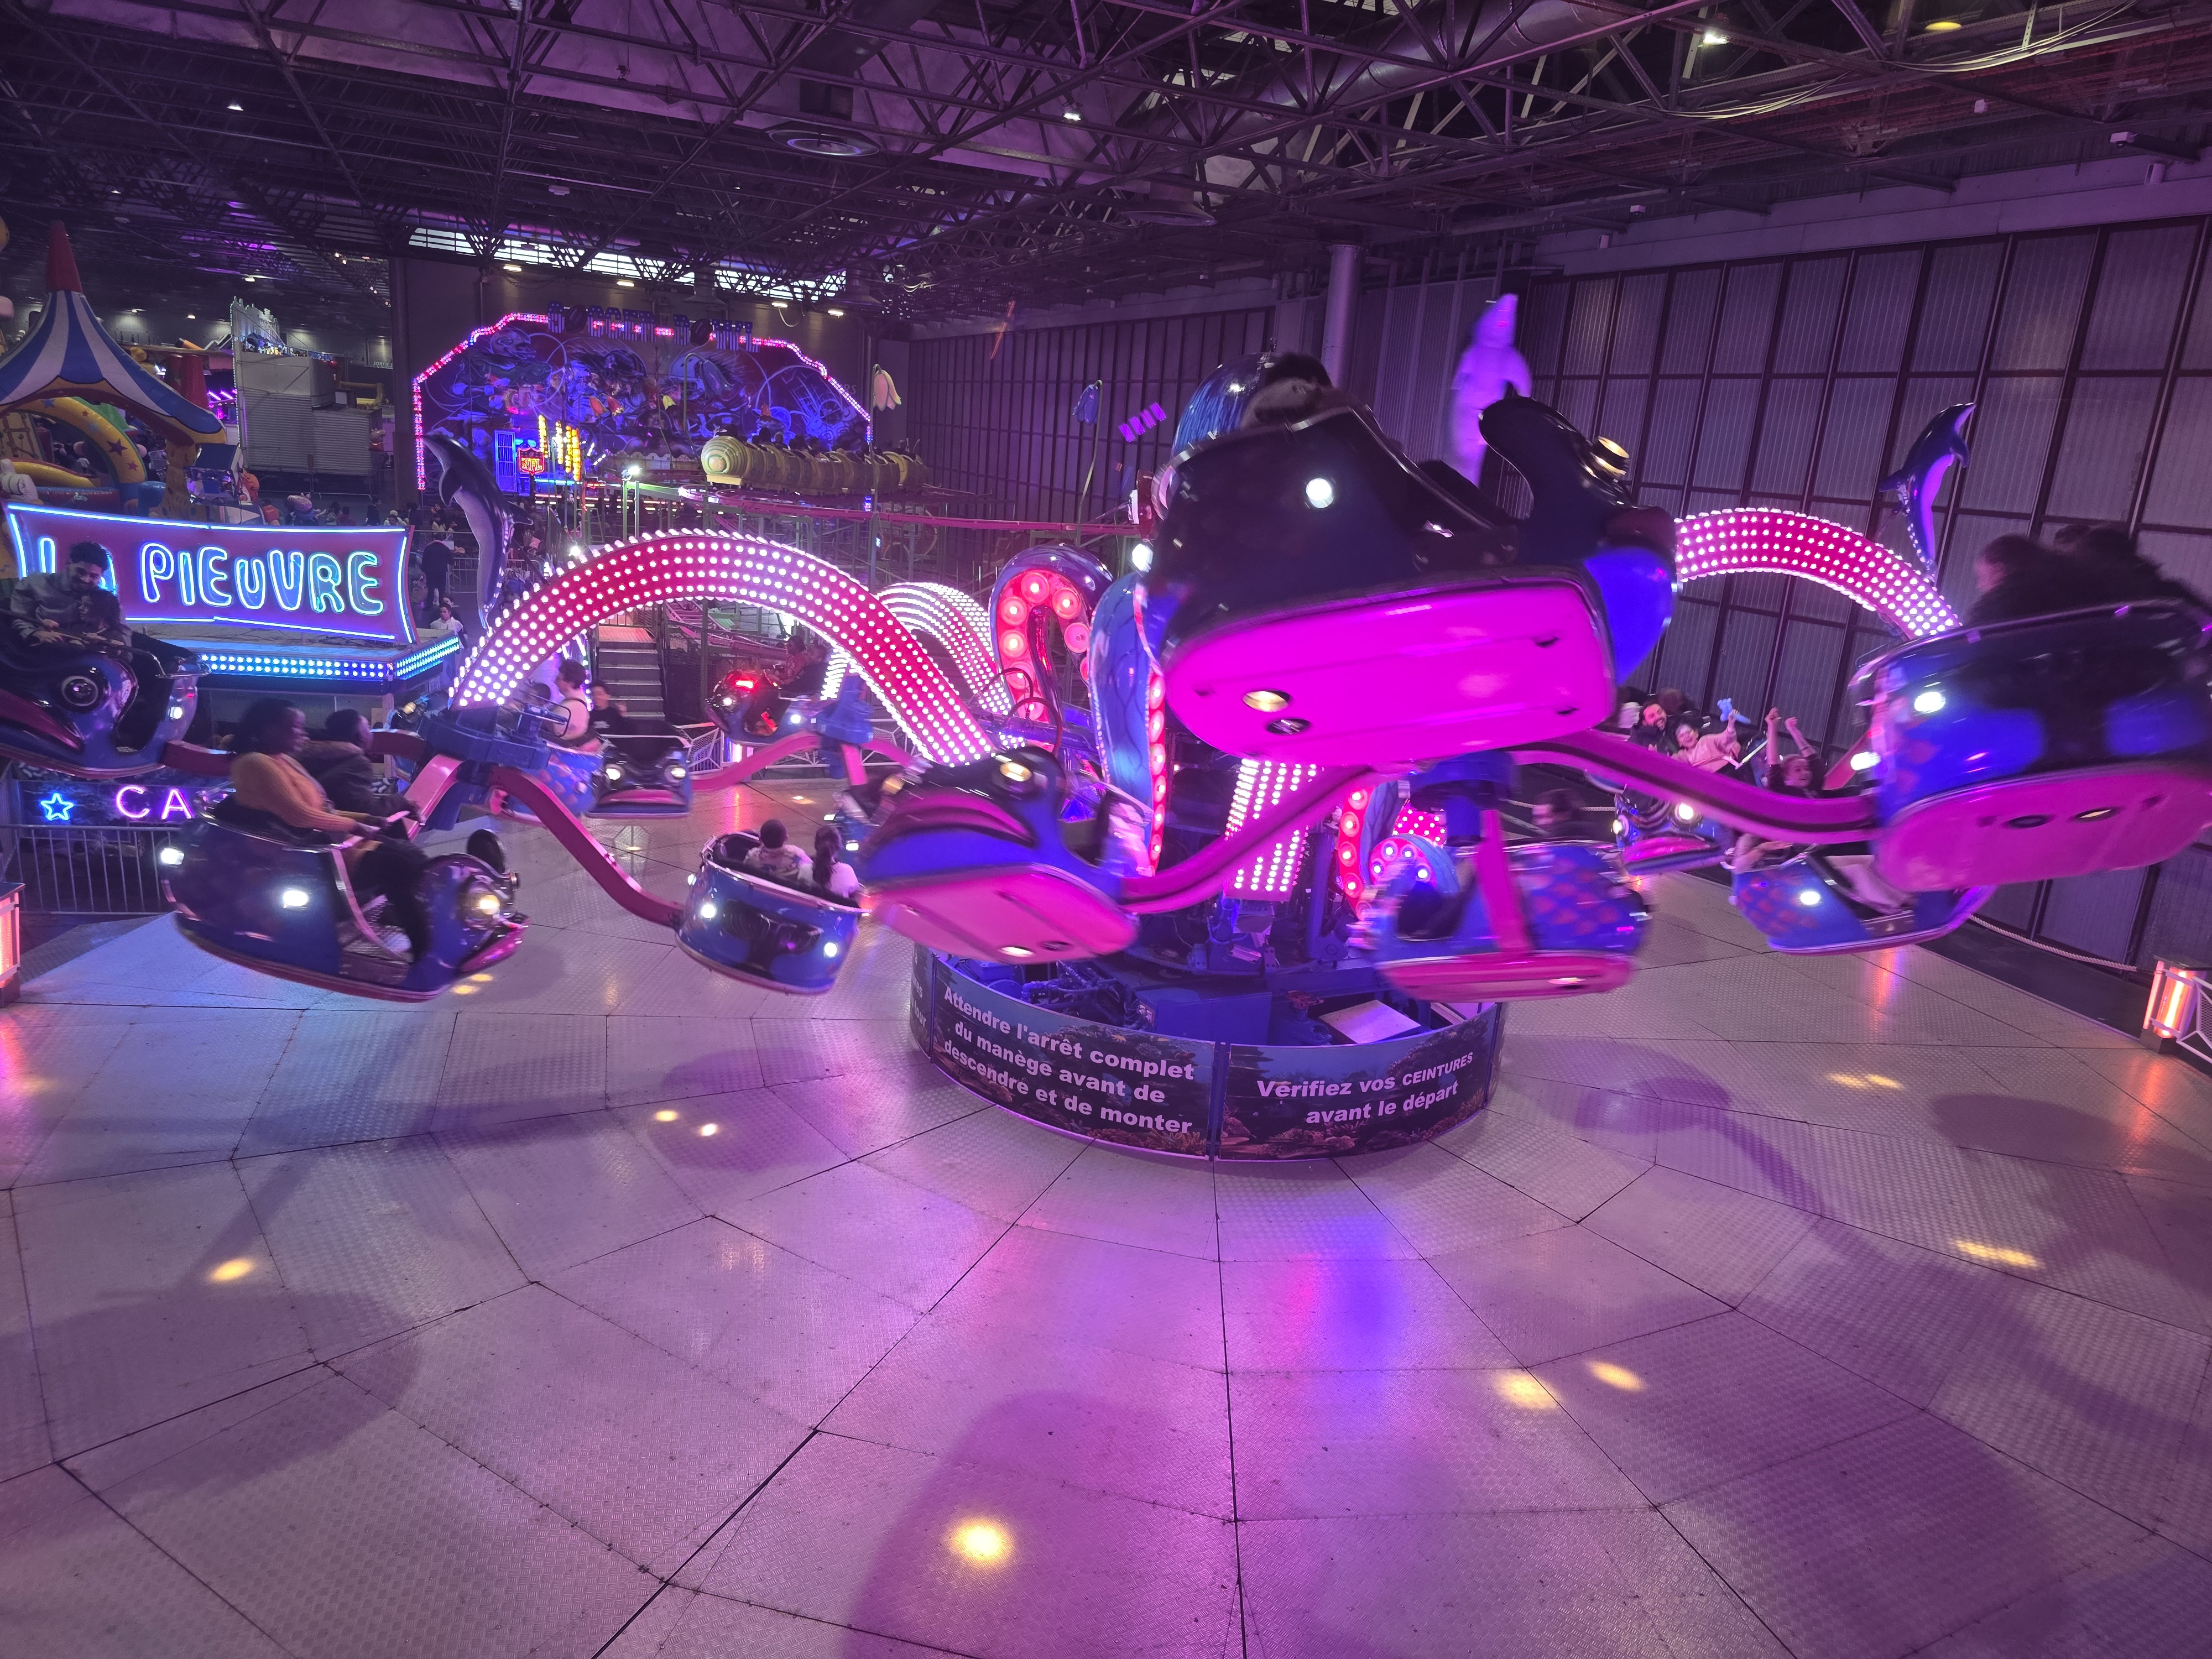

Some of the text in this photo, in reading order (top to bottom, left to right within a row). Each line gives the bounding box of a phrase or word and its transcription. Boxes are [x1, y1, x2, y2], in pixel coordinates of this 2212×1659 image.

[140, 541, 385, 615] PIEUVRE
[944, 986, 1011, 1034] Attendre
[1018, 1023, 1082, 1059] l'arrêt
[1089, 1050, 1194, 1081] complet
[955, 1021, 1165, 1103] du manège avant de
[1359, 1076, 1395, 1093] vos
[1402, 1052, 1474, 1086] CEINTURES
[945, 1040, 1193, 1134] descendre et de monter
[1306, 1079, 1459, 1124] avant le départ
